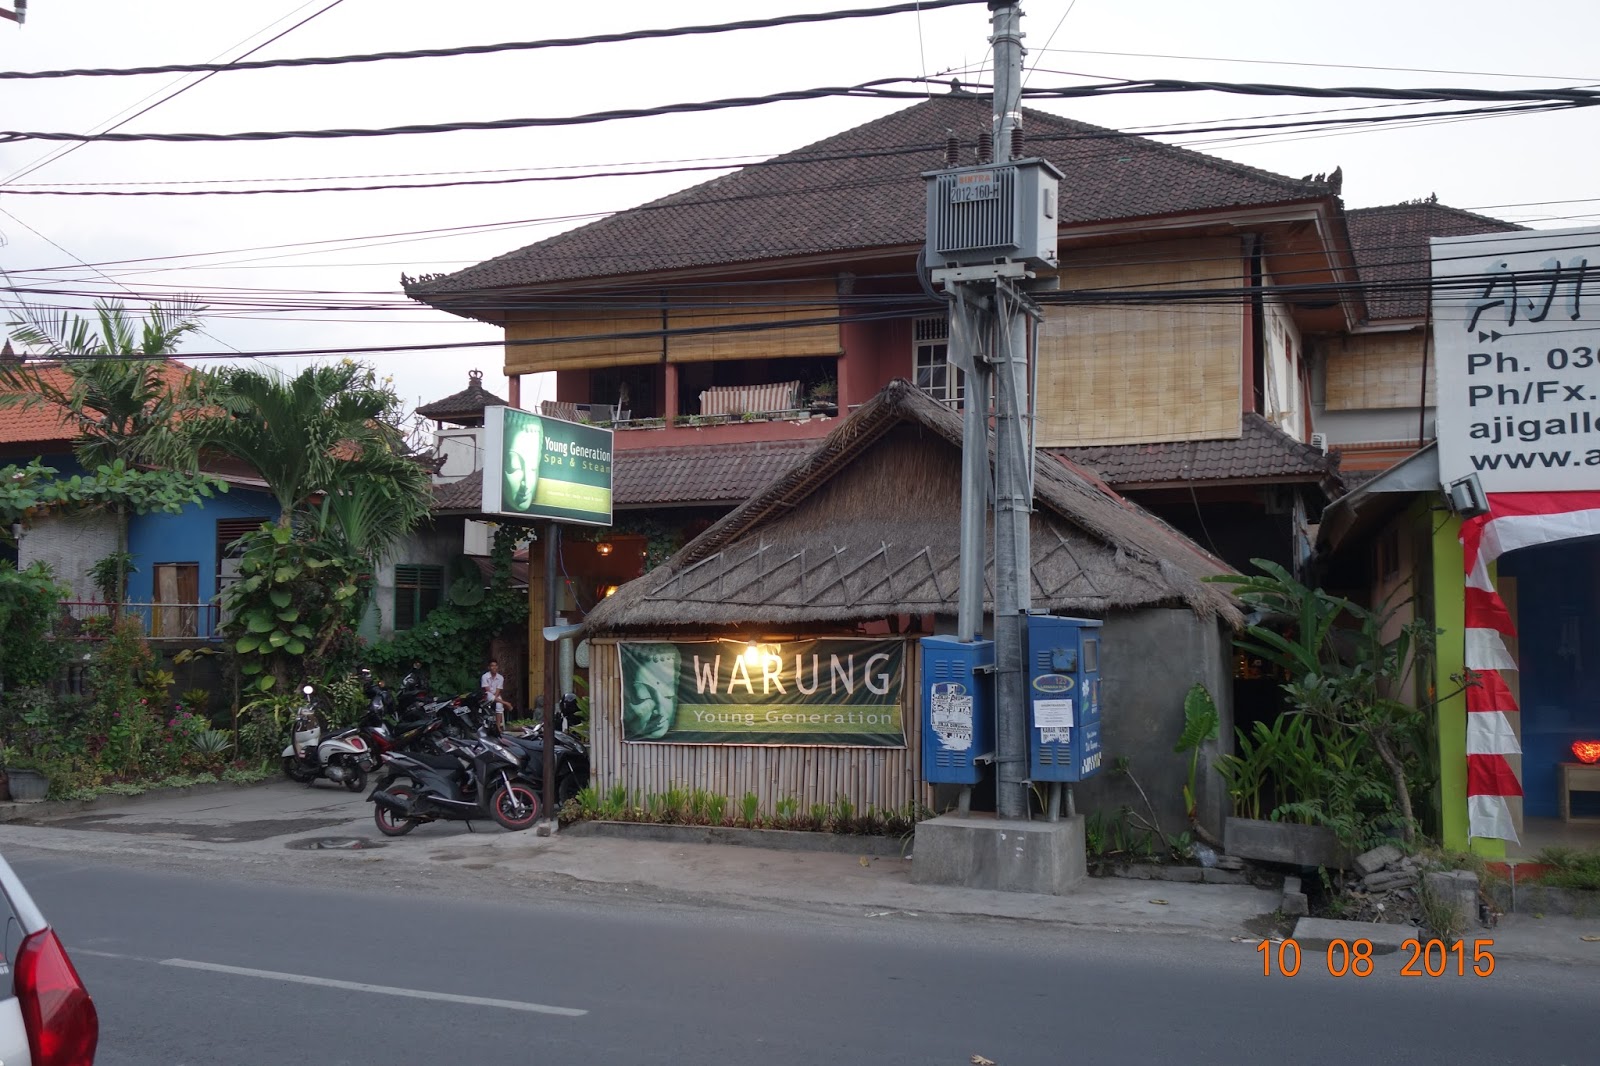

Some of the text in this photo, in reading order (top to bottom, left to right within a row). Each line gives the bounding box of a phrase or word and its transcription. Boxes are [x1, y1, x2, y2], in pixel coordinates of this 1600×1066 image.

[951, 183, 999, 202] 2012-160-H
[1467, 347, 1600, 375] Ph. 03
[1469, 381, 1597, 407] Ph/Fx.
[544, 436, 610, 463] Young Generation
[544, 453, 563, 465] Spa
[569, 457, 575, 467] &
[693, 652, 890, 695] WARUNG
[693, 710, 892, 725] Young Generation
